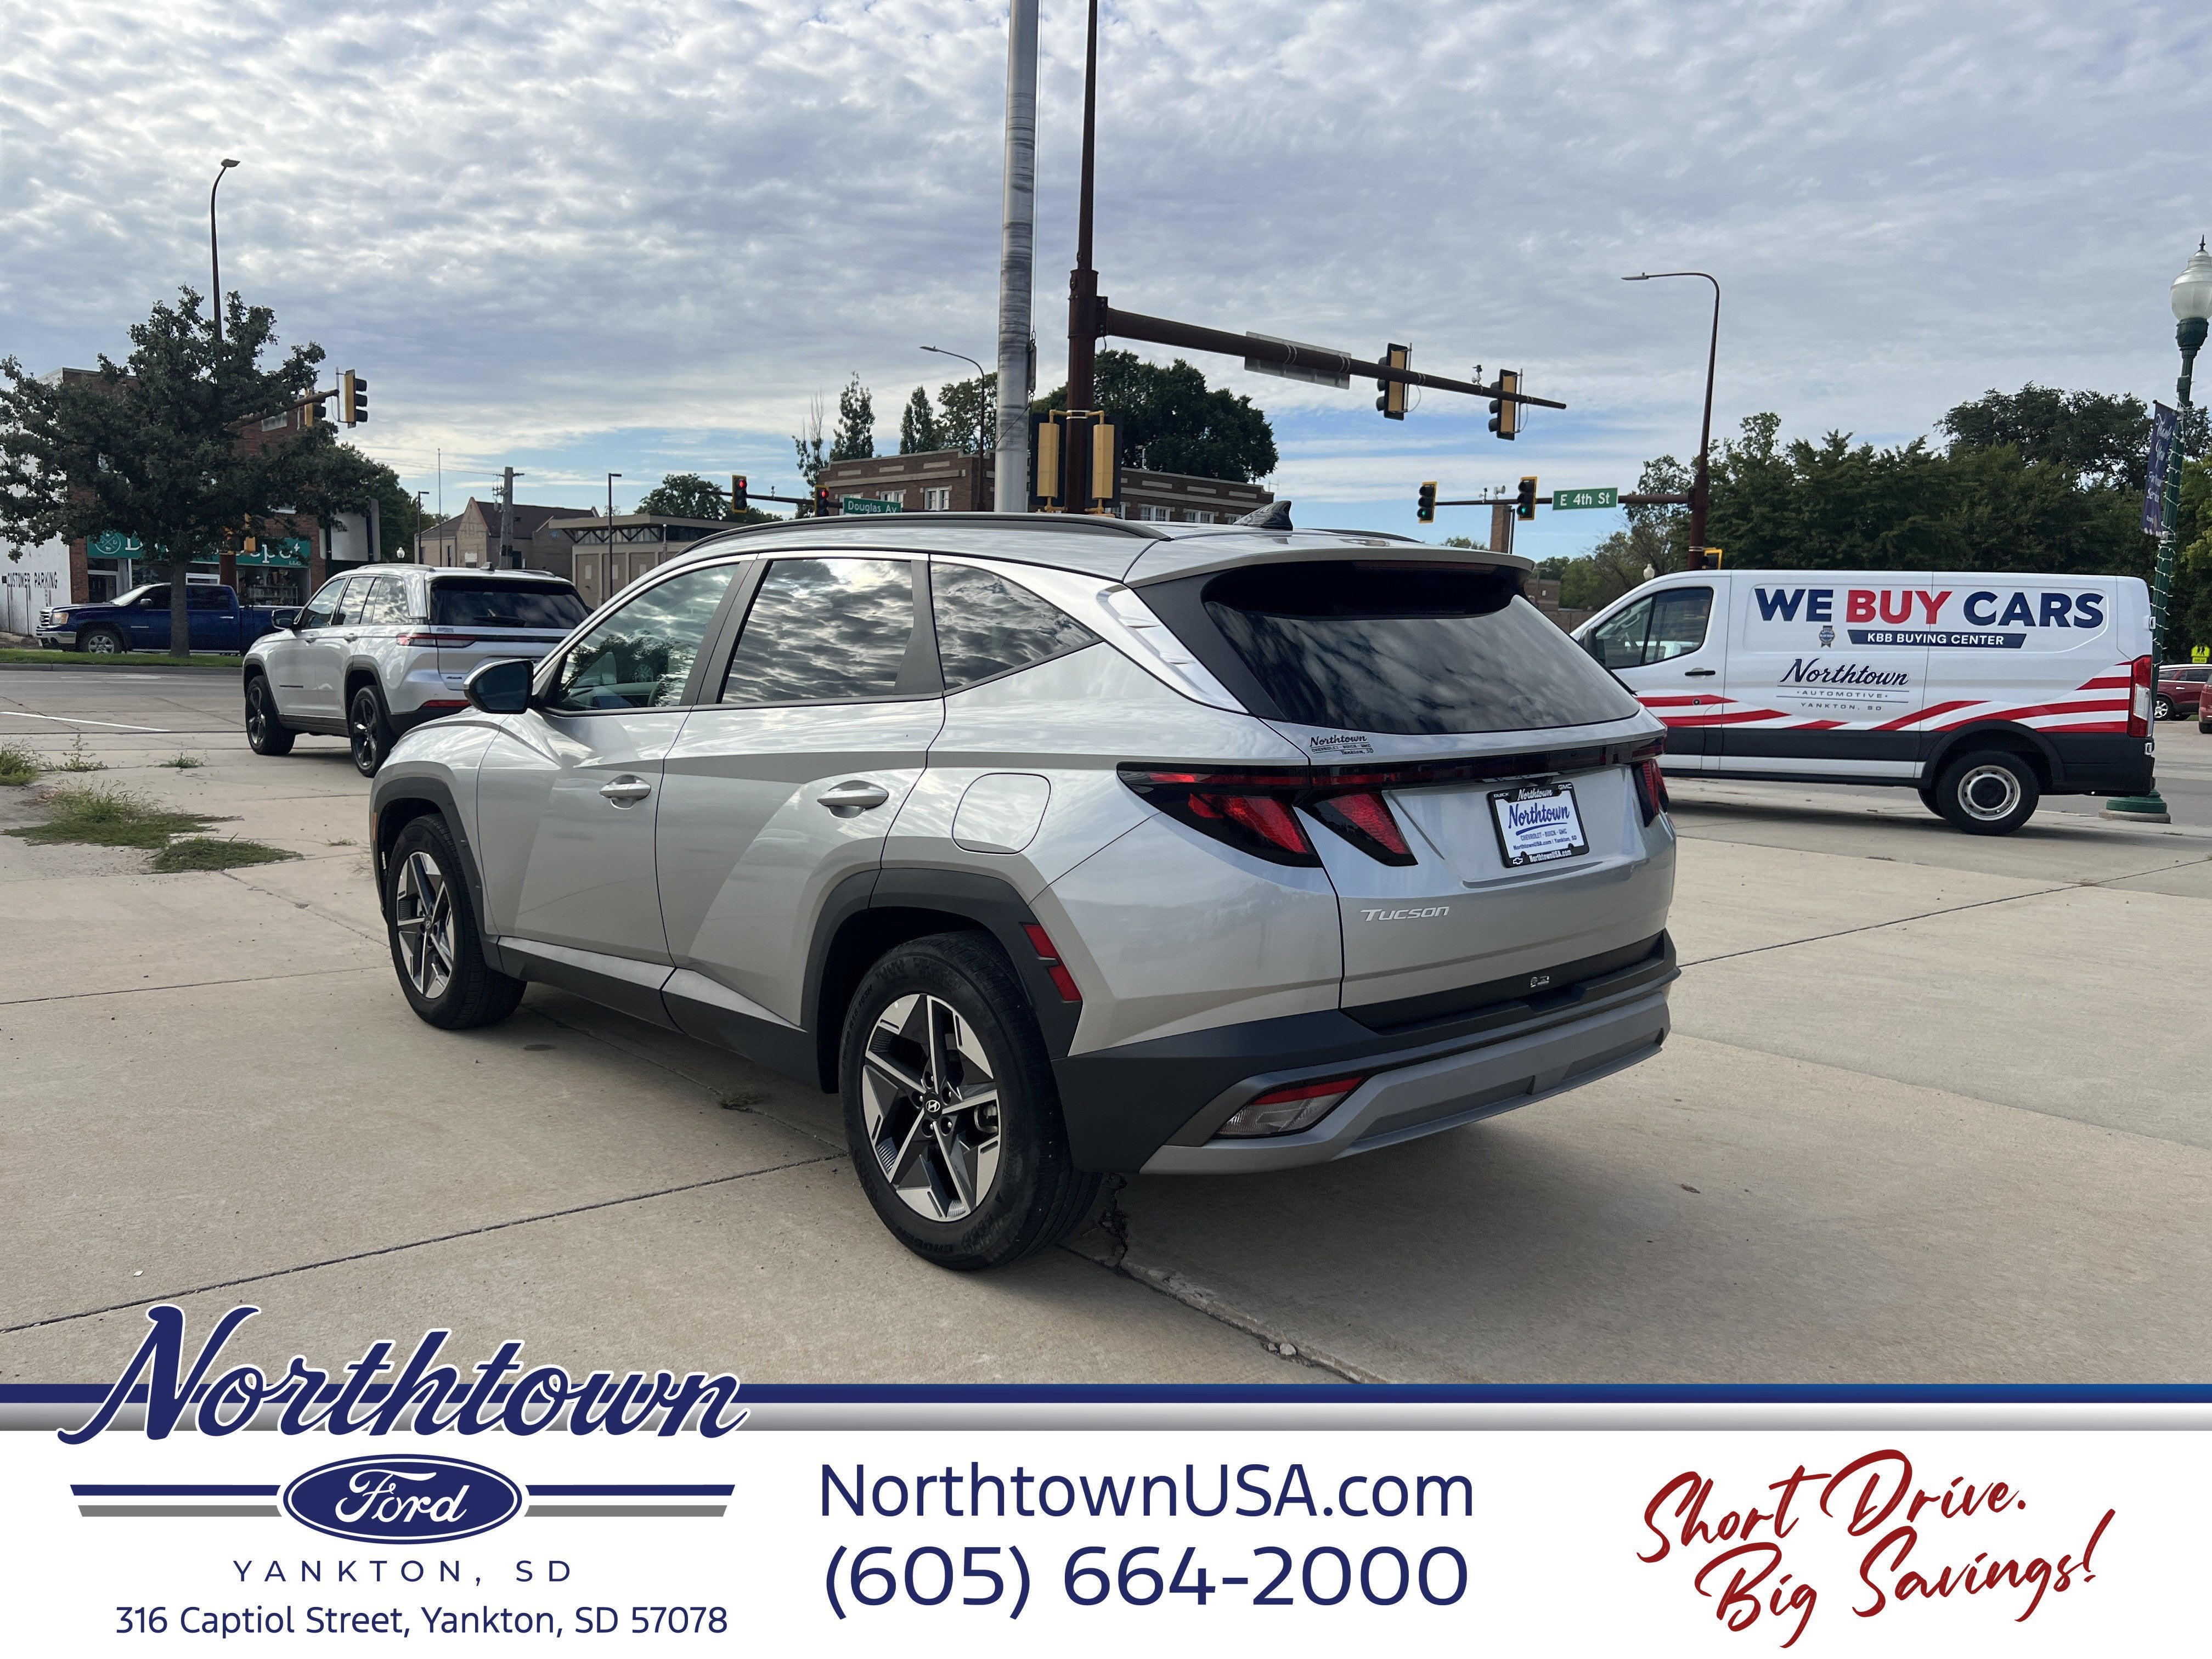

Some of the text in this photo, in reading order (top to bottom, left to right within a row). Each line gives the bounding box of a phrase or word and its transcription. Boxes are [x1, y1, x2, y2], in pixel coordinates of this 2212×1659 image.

[1560, 492, 1610, 506] E 4th St
[848, 500, 898, 514] Douglas Av
[7, 572, 58, 589] CUSTOMER PARKING
[1754, 588, 2104, 629] WE BUY CARS
[1867, 633, 2004, 645] KBB BUYING CENTER
[1780, 658, 1909, 686] Northtown
[1802, 690, 1883, 699] AUTOMOTIVE
[1801, 702, 1860, 711] YANKTON,
[1310, 735, 1367, 747] Northtown
[1517, 788, 1553, 801] Northtown
[1509, 803, 1570, 828] Northtown
[1513, 840, 1552, 850] NorthtownUSA.com
[1528, 849, 1572, 862] NorthtownUSA.com
